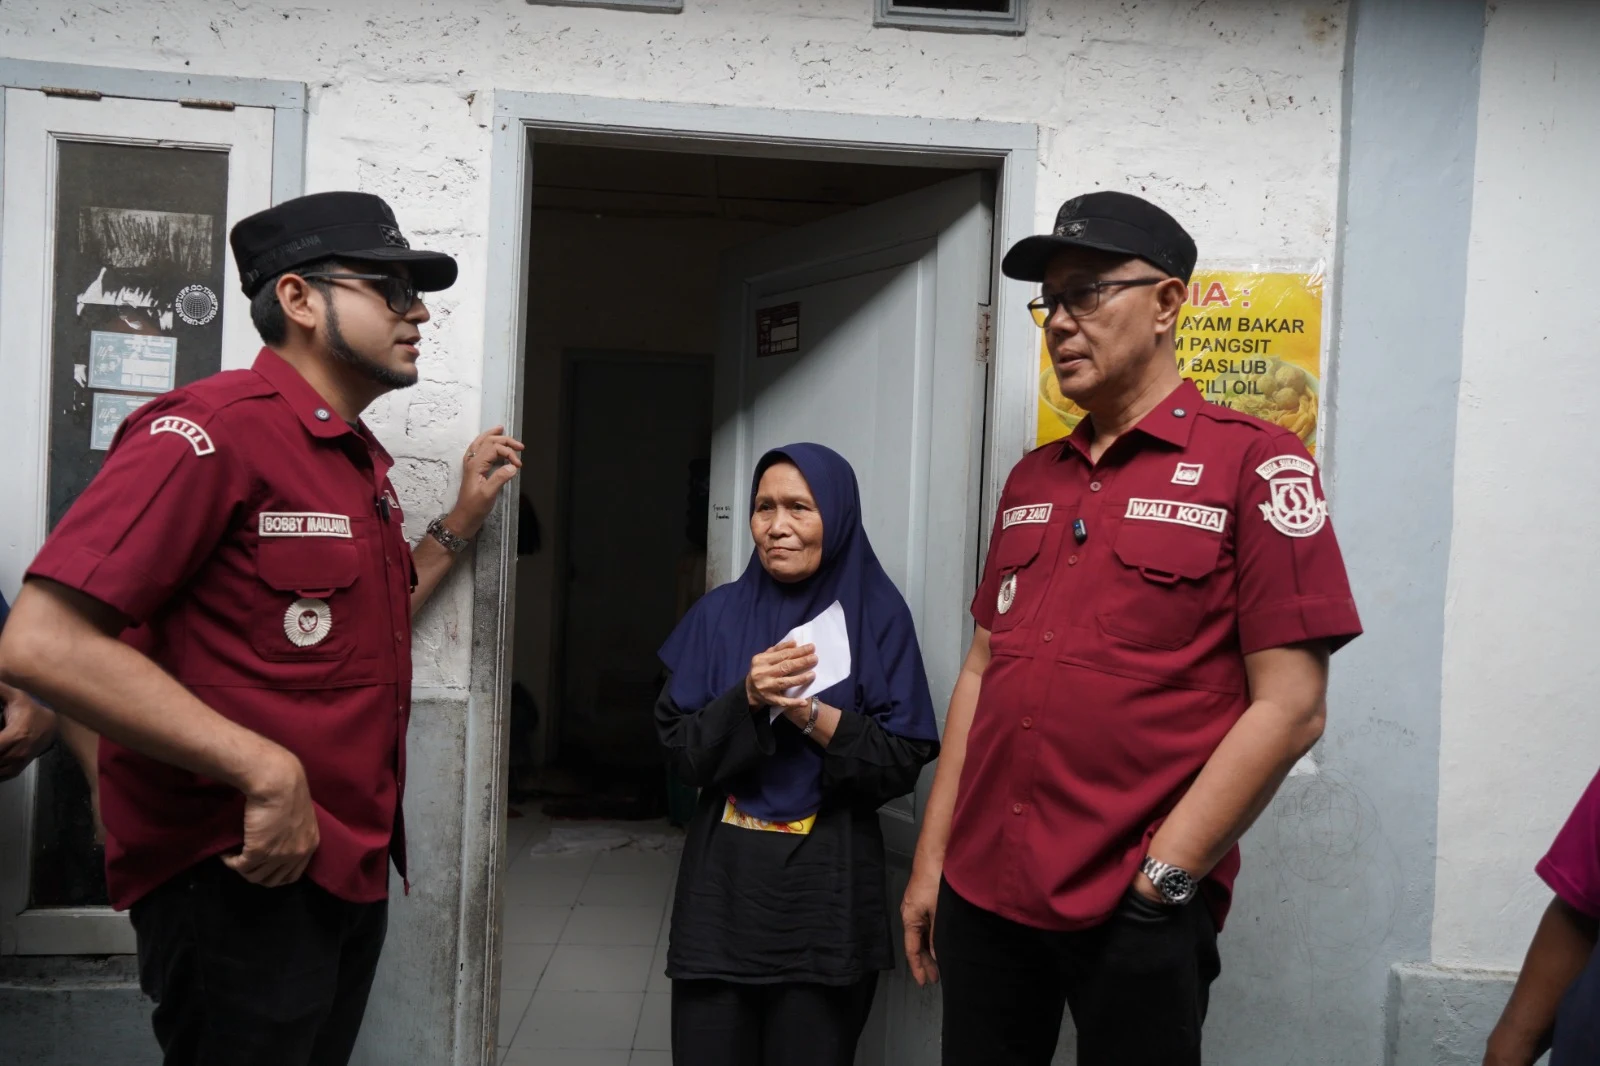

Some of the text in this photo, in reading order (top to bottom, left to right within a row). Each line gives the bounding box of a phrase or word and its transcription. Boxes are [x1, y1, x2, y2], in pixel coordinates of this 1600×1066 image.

[1181, 316, 1305, 334] AYAM BAKAR
[1190, 337, 1272, 354] PANGSIT
[1191, 358, 1267, 375] BASLUB
[1233, 380, 1264, 395] OIL
[1132, 502, 1219, 527] WALI KOTA
[264, 516, 349, 534] BOBBY MAULANA
